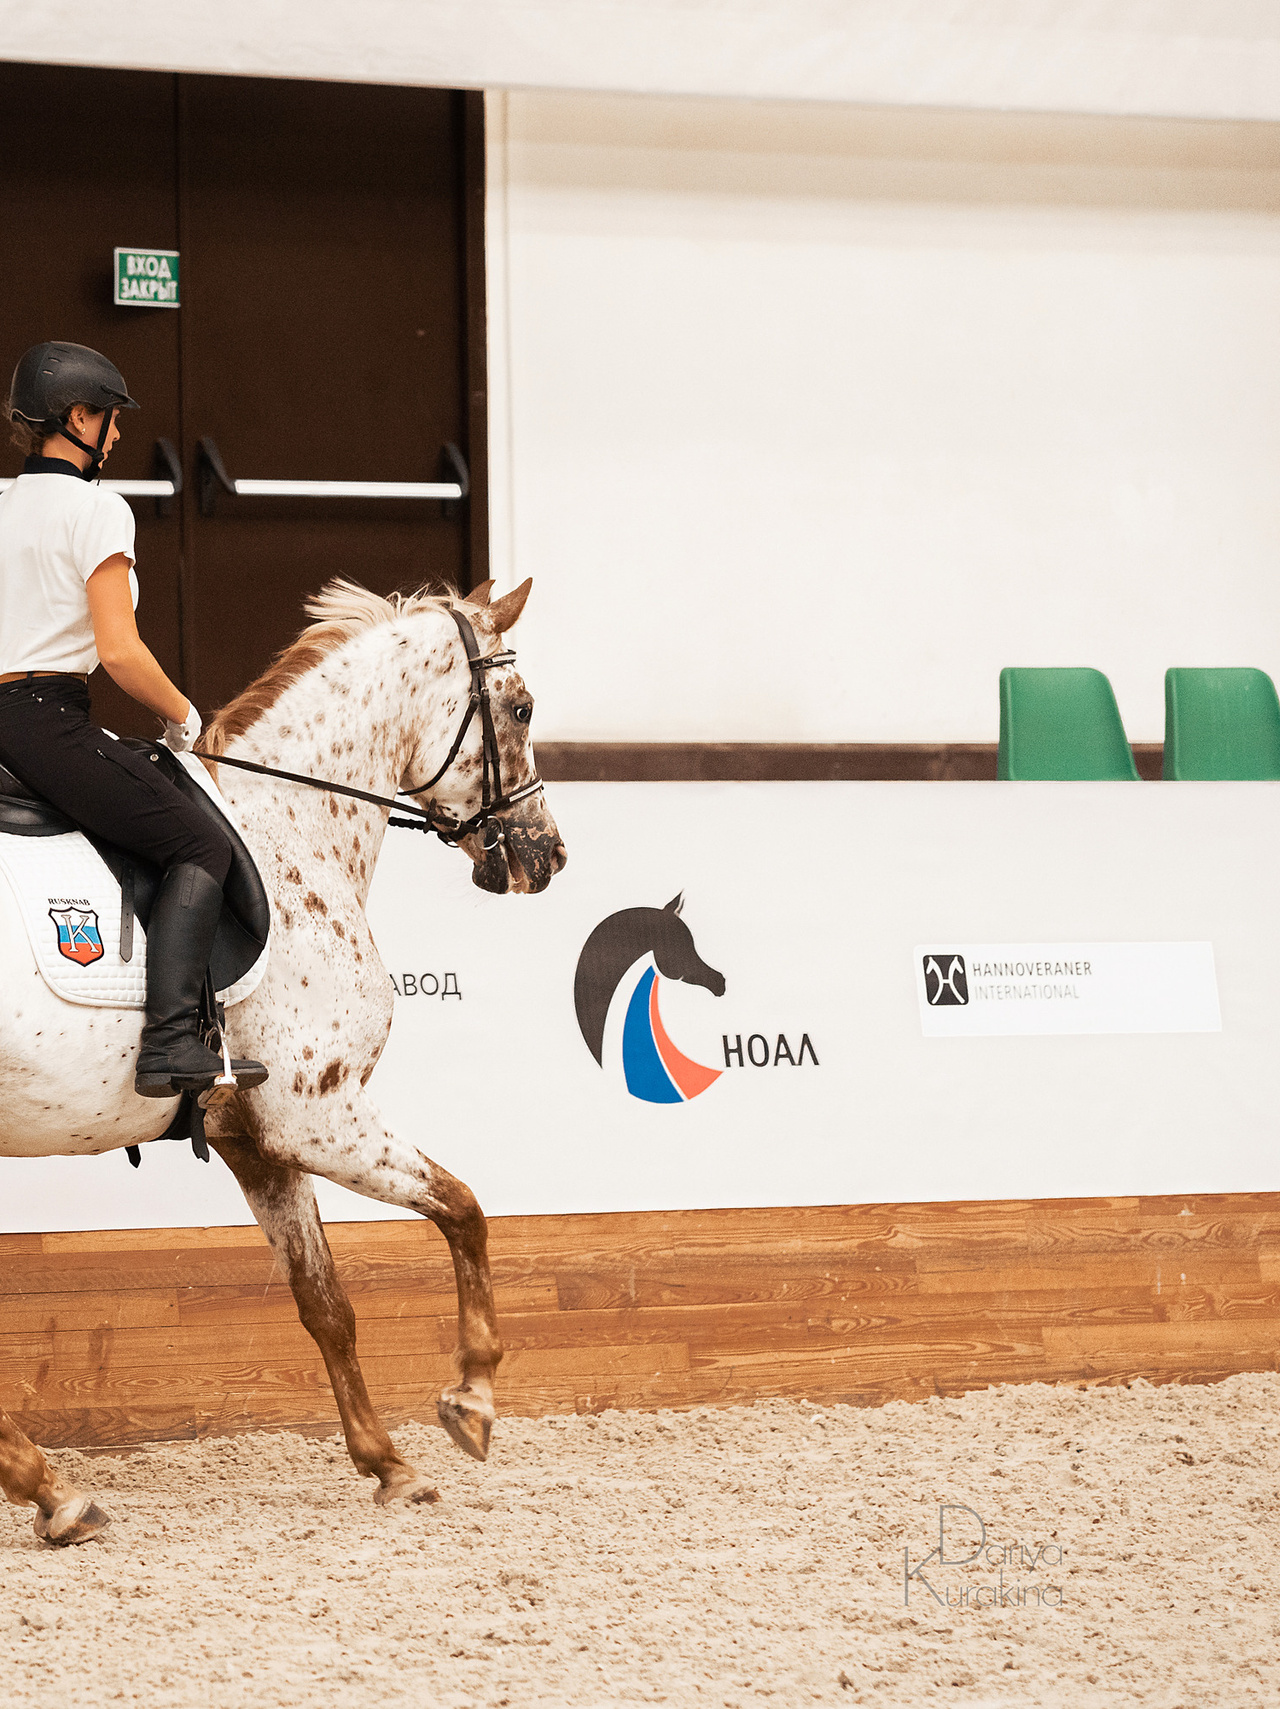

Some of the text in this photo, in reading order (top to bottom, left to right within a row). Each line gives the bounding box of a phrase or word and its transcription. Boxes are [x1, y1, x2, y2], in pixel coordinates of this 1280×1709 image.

[126, 255, 172, 279] ВХОД
[120, 277, 178, 301] ЗАКРЫТ
[972, 961, 1092, 977] HANNOVERANER
[974, 984, 1081, 1001] INTERNATIONAL
[722, 1033, 820, 1068] НОАЛ
